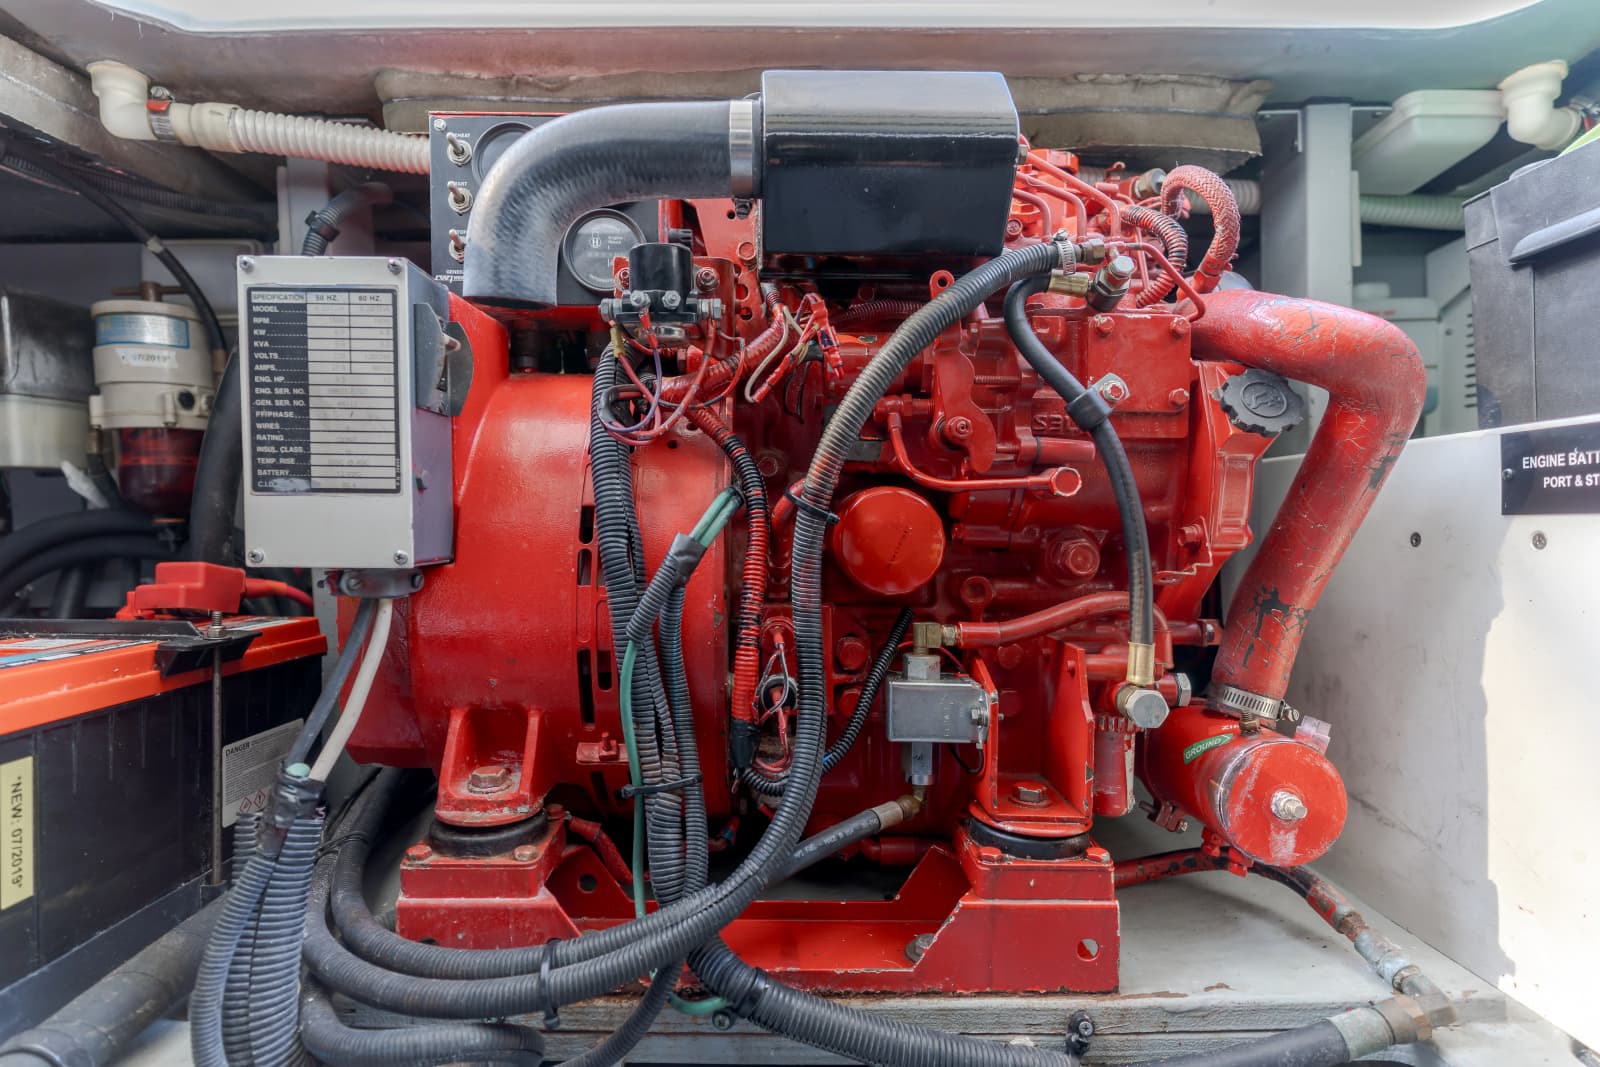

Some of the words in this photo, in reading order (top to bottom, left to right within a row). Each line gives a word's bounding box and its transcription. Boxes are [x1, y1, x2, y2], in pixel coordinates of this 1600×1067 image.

[252, 305, 280, 313] MODEL
[253, 328, 266, 336] KW
[1522, 453, 1566, 469] ENGINE
[1543, 475, 1573, 488] PORT
[1574, 474, 1583, 487] &
[1585, 473, 1600, 486] ST
[225, 741, 250, 757] DANGER
[1185, 738, 1222, 759] GROUND
